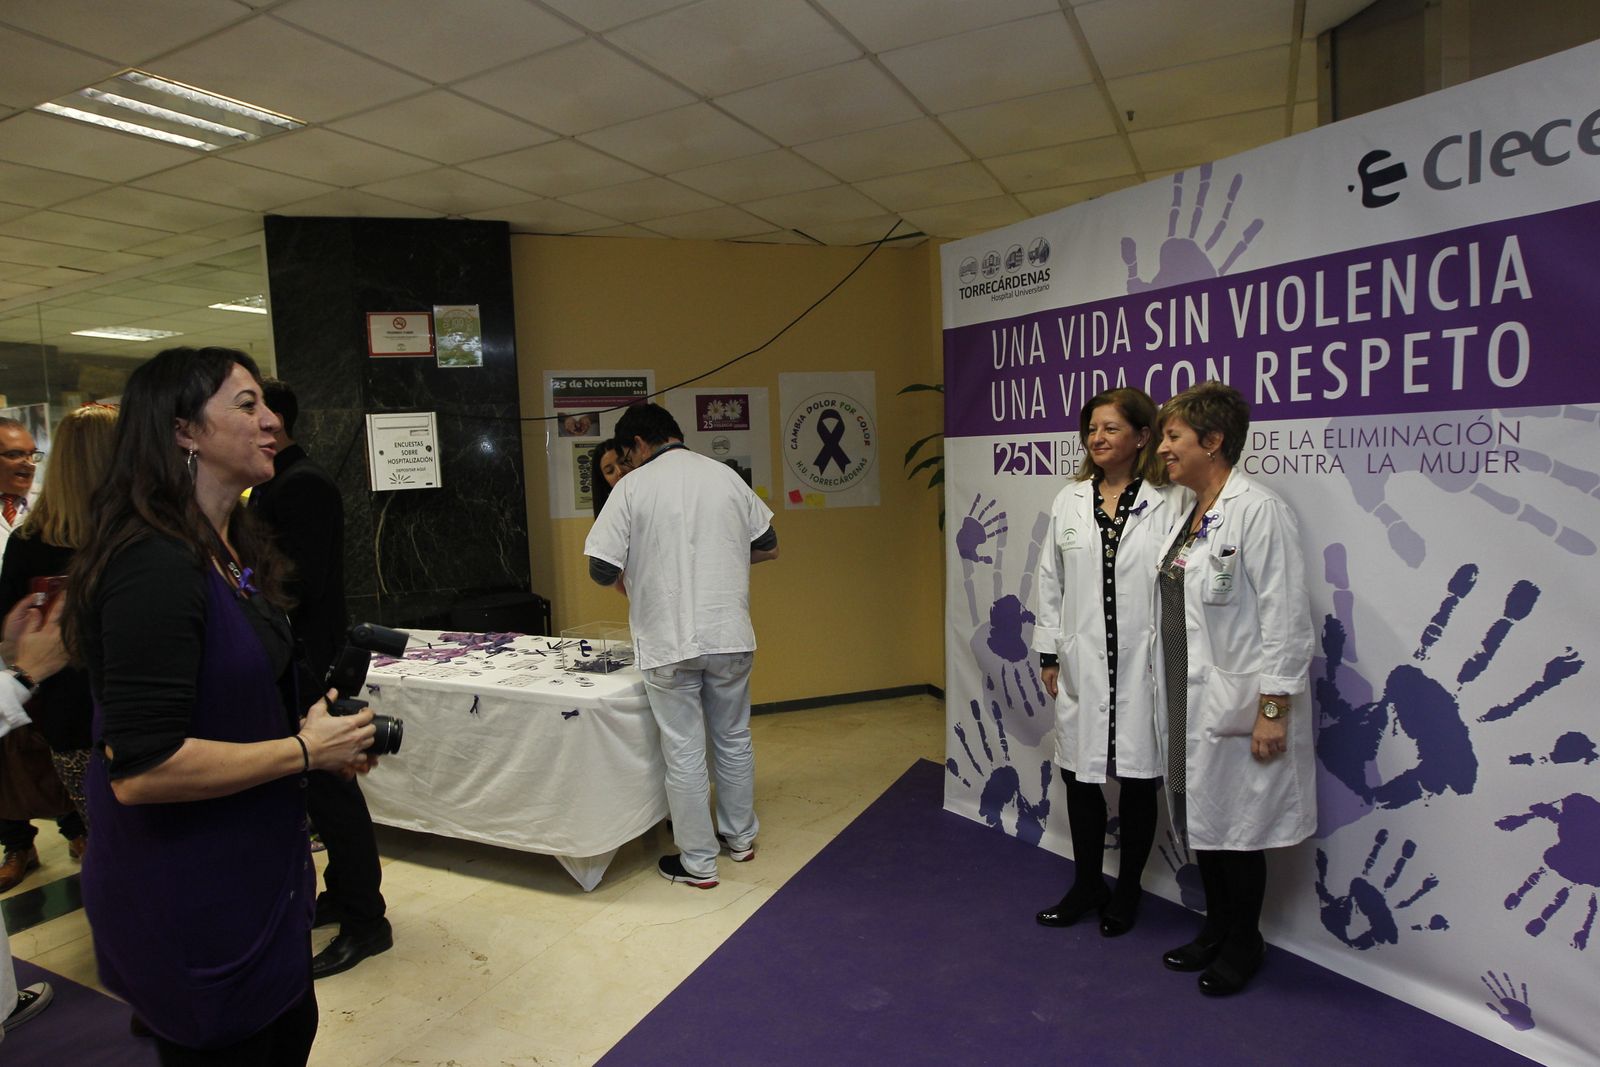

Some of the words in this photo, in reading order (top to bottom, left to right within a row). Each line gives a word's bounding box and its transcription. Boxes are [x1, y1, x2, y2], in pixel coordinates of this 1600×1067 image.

[959, 268, 1051, 300] TORRECÁRDENAS
[991, 290, 1014, 302] Hospital
[1014, 284, 1050, 298] Universitario
[992, 321, 1046, 370] UNA
[1058, 306, 1131, 361] VIDA
[1145, 292, 1209, 352] SIN
[1229, 234, 1533, 339] VIOLENCIA
[553, 380, 567, 389] 25
[569, 379, 583, 388] de
[584, 379, 643, 388] Noviembre
[991, 376, 1047, 422] UNA
[1255, 321, 1530, 404] RESPETO
[703, 420, 714, 429] 25
[790, 414, 807, 450] CAMBIA
[806, 399, 837, 415] DOLOR
[839, 401, 857, 415] POR
[856, 415, 871, 447] COLOR
[1061, 435, 1086, 456] DÍA
[1253, 431, 1280, 451] DE
[1289, 429, 1315, 450] LA
[1323, 414, 1521, 449] ELIMINACIÓN
[387, 456, 433, 464] HOSPITALIZACIÓN
[809, 457, 868, 486] TORRECÁRDENAS
[994, 440, 1056, 476] 25N
[1061, 459, 1080, 476] DE
[1244, 454, 1345, 475] CONTRA
[1367, 452, 1397, 474] LA
[1419, 450, 1521, 475] MUJER
